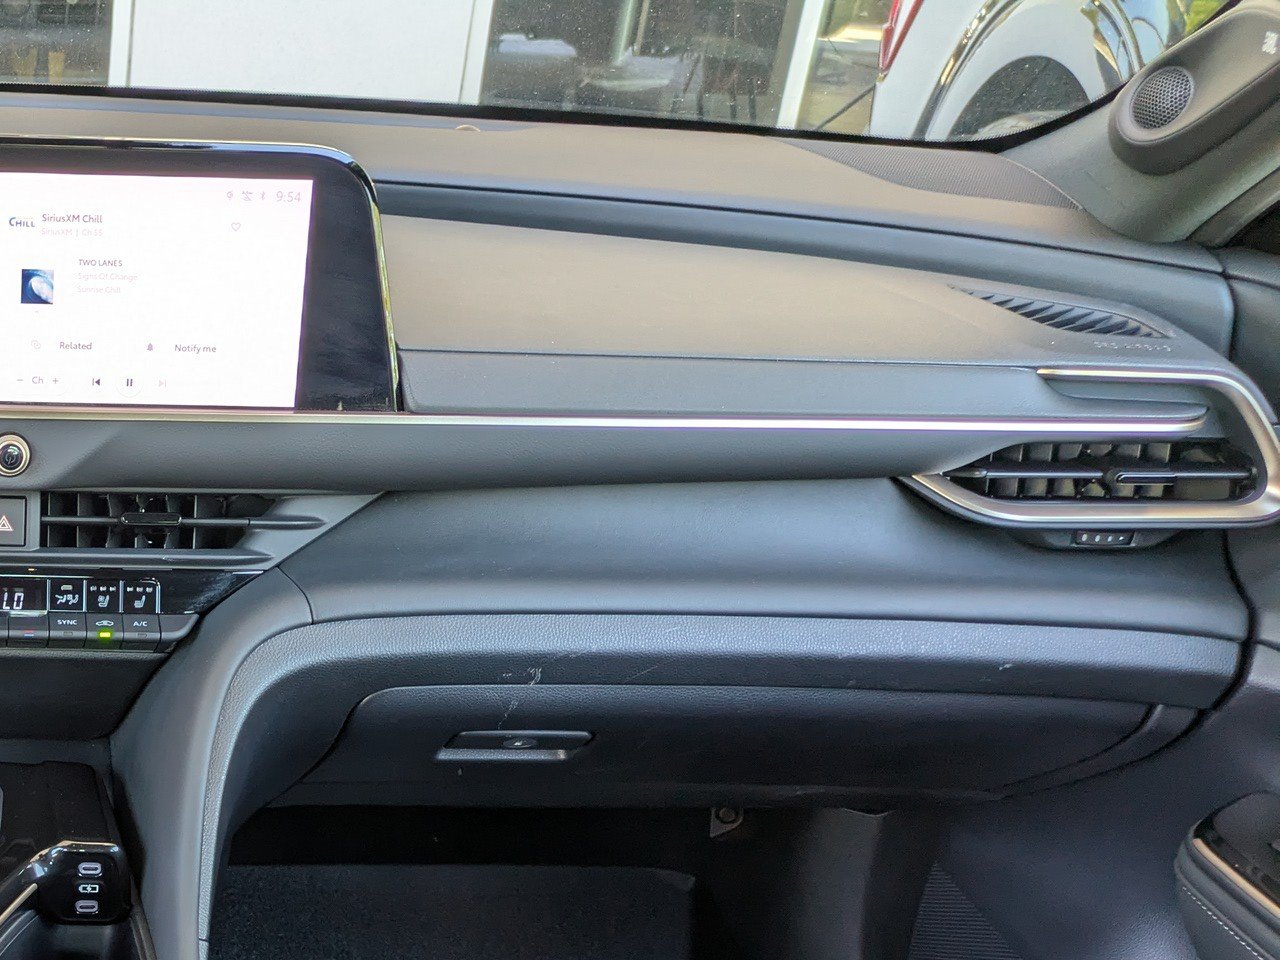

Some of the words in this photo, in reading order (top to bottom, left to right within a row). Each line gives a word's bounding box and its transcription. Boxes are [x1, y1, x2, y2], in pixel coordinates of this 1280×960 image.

[275, 190, 301, 202] 9:54
[8, 216, 36, 228] CHILL
[41, 213, 80, 224] SiriusXM
[82, 214, 103, 224] Chill
[78, 259, 97, 267] TWO
[98, 259, 123, 267] LANES
[59, 342, 93, 351] Related
[174, 344, 201, 354] Notify
[31, 376, 44, 385] Ch
[2, 592, 25, 610] LO
